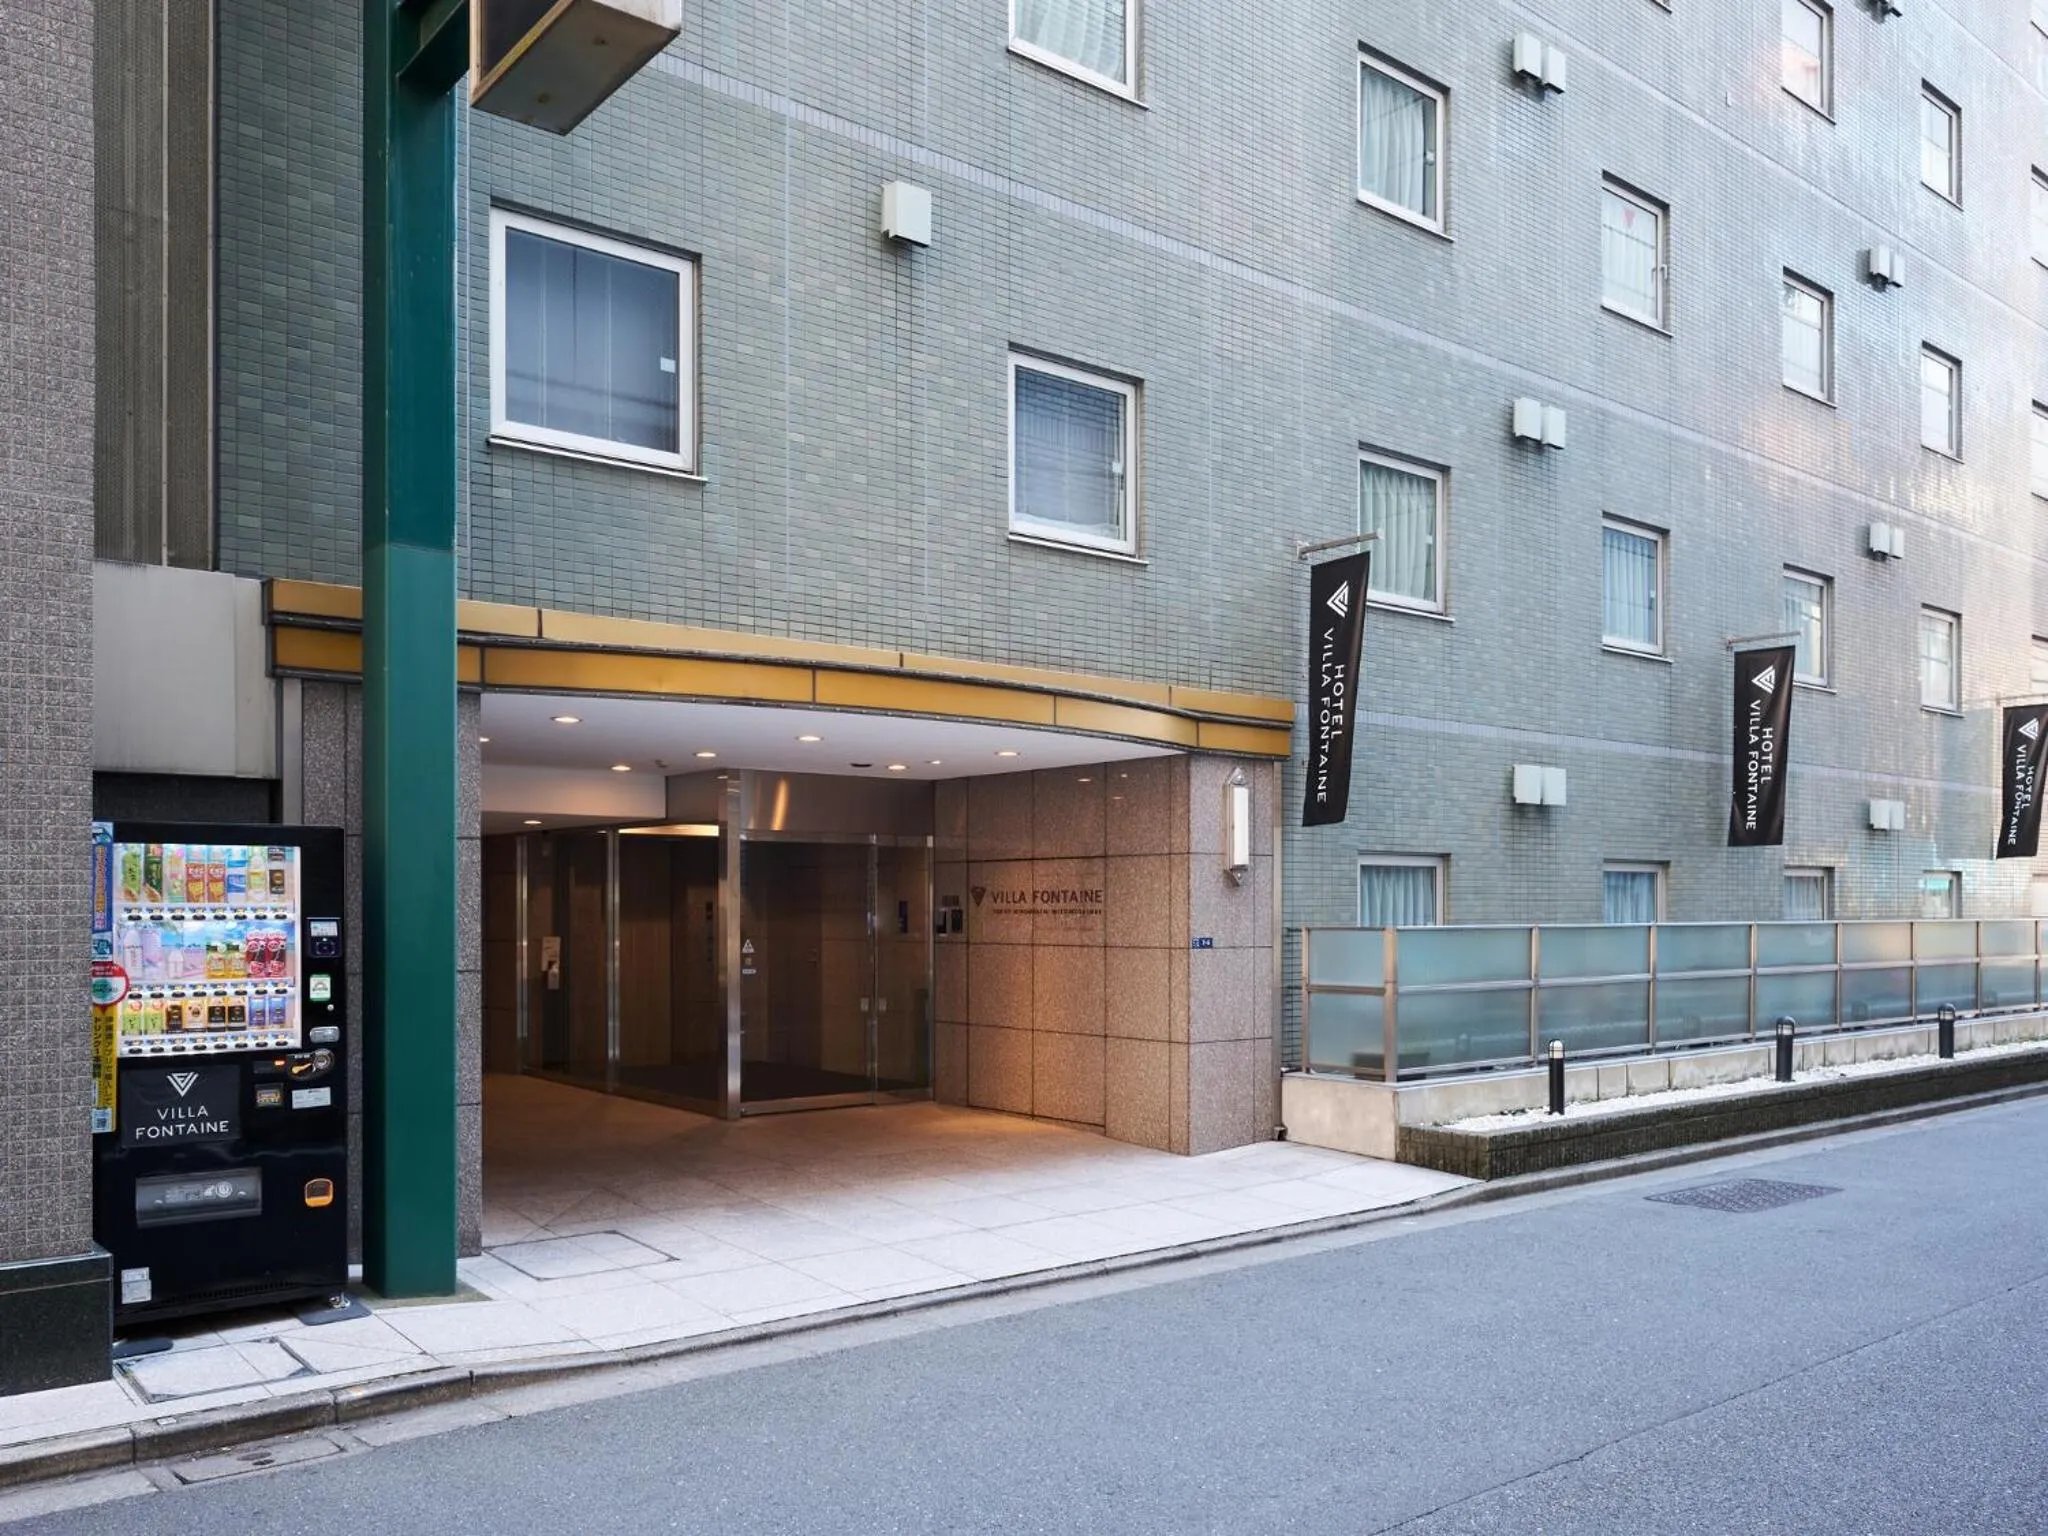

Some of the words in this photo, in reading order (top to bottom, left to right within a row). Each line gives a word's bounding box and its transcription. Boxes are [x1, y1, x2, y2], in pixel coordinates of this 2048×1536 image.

[1321, 628, 1334, 687] VILLA
[1331, 664, 1346, 739] HOTEL
[1748, 699, 1761, 745] VILLA
[1316, 697, 1331, 803] FONTAINE
[1761, 727, 1773, 784] HOTEL
[2016, 745, 2026, 779] VILLA
[1746, 751, 1760, 829] FONTAINE
[2021, 766, 2035, 809] HOTEL
[2008, 785, 2023, 845] FONTAINE
[992, 891, 1026, 904] VILLA
[1032, 889, 1103, 904] FONTAINE
[135, 1120, 229, 1140] FONTAINE
[157, 1105, 209, 1119] VILLA
